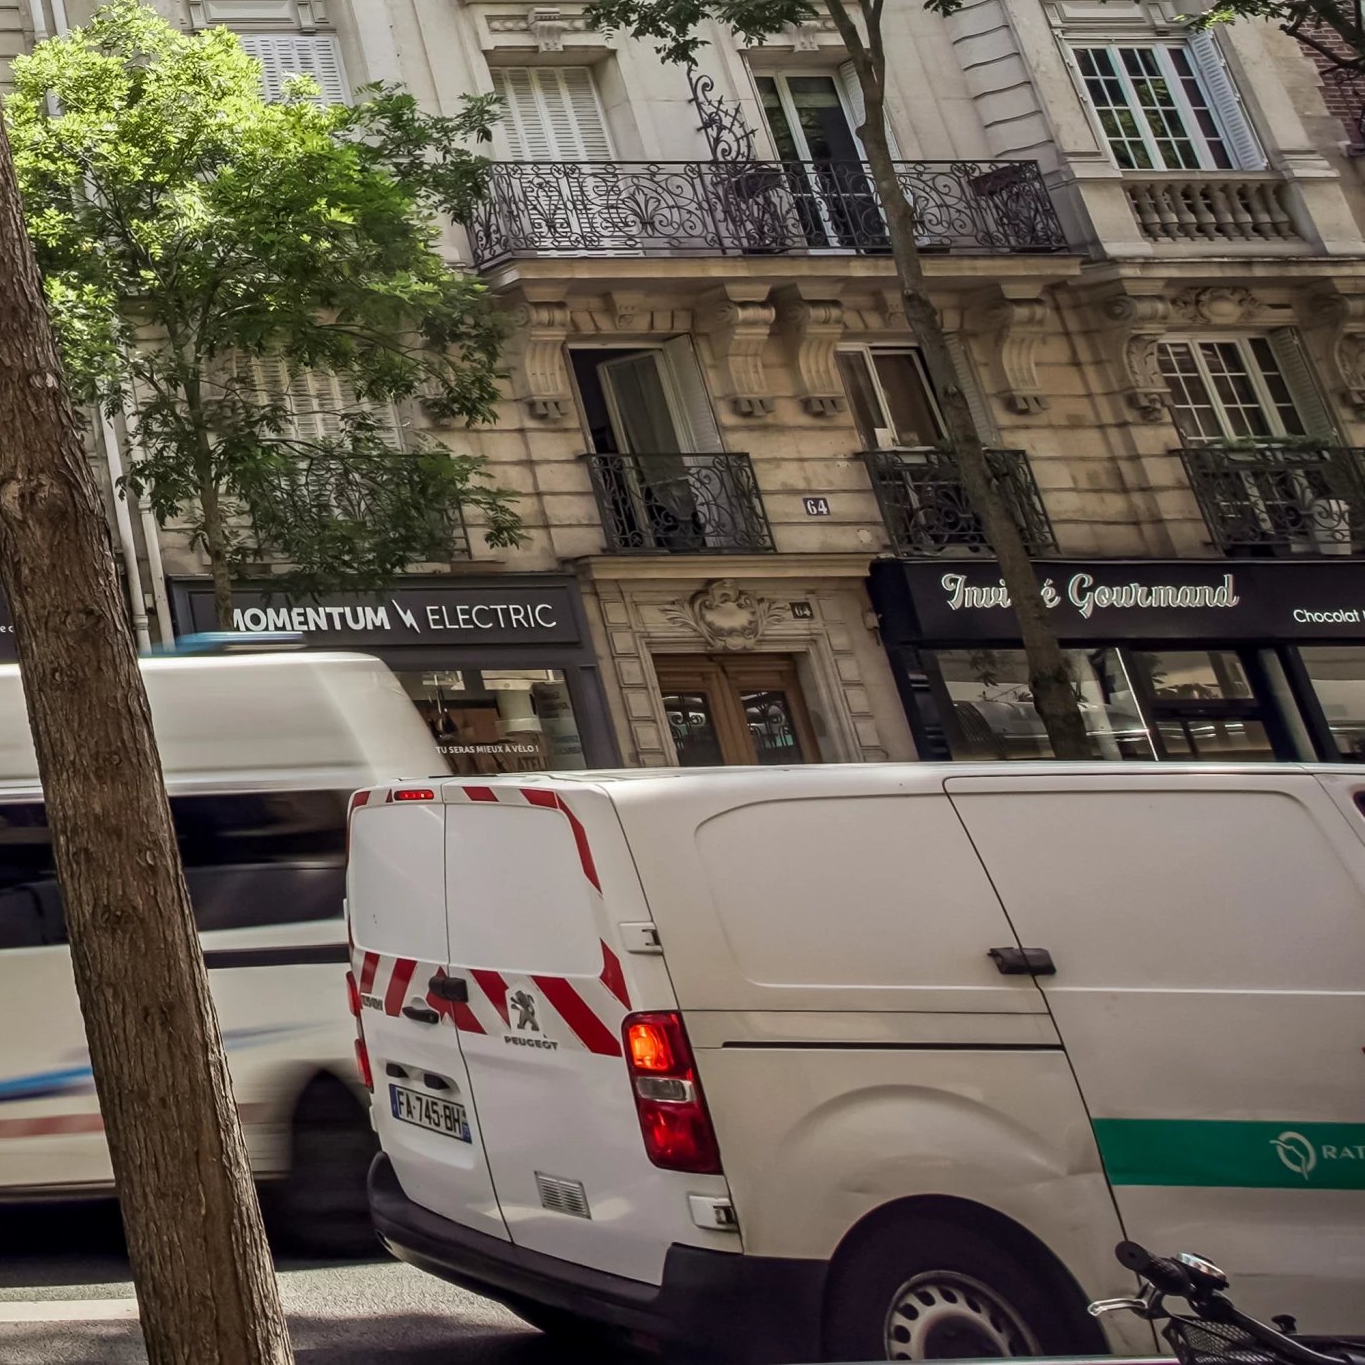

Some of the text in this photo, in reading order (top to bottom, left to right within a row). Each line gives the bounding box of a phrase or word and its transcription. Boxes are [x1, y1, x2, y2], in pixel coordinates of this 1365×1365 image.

[807, 500, 827, 514] 64
[941, 573, 1240, 619] Invié Gourmand
[426, 604, 556, 629] ELECTRIC
[1293, 609, 1360, 622] Chocolat
[476, 745, 504, 753] MIEUX
[512, 744, 534, 752] VÉLO
[503, 1035, 559, 1050] PEUGEOT
